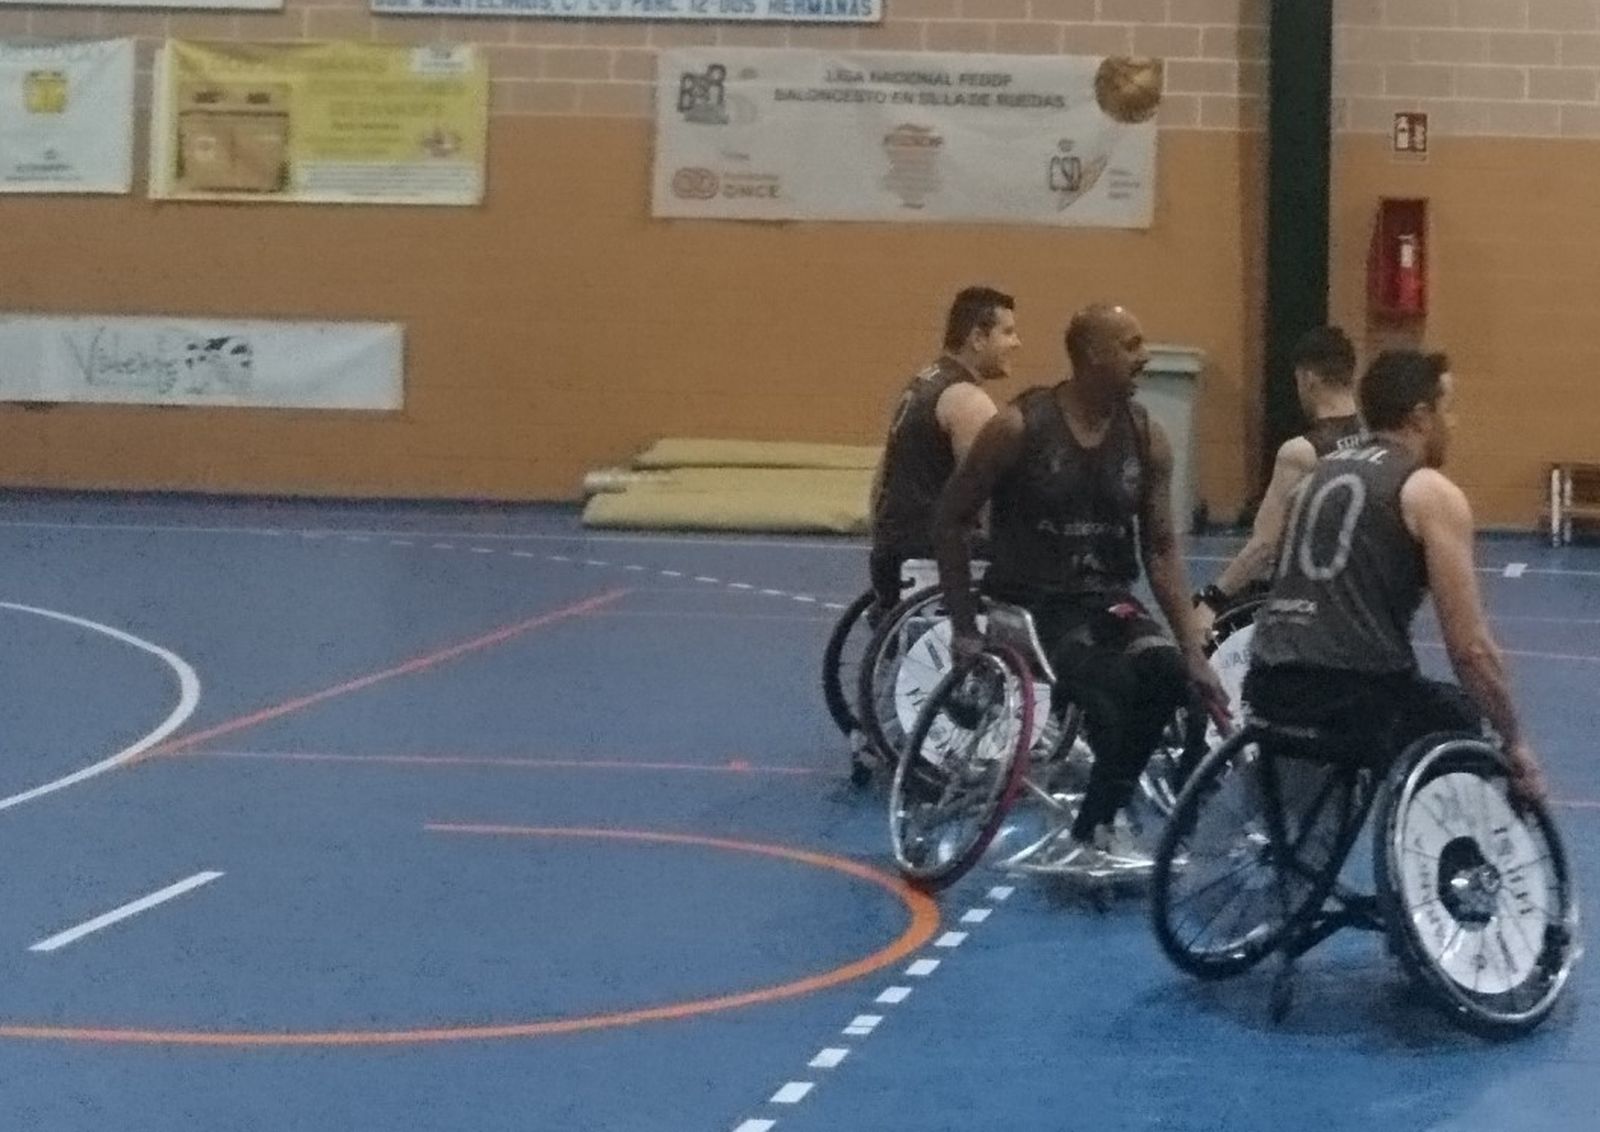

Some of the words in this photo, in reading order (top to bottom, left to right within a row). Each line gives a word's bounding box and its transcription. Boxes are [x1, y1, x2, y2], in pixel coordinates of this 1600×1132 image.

[767, 0, 872, 16] HERMANAS
[870, 70, 952, 86] NACIONAL
[773, 88, 888, 103] BALONCESTO
[891, 91, 914, 104] EN
[918, 92, 966, 106] SILLA
[968, 93, 991, 107] DE
[996, 94, 1066, 108] RUEDAS
[722, 184, 779, 199] ONCE
[1278, 471, 1368, 581] 10
